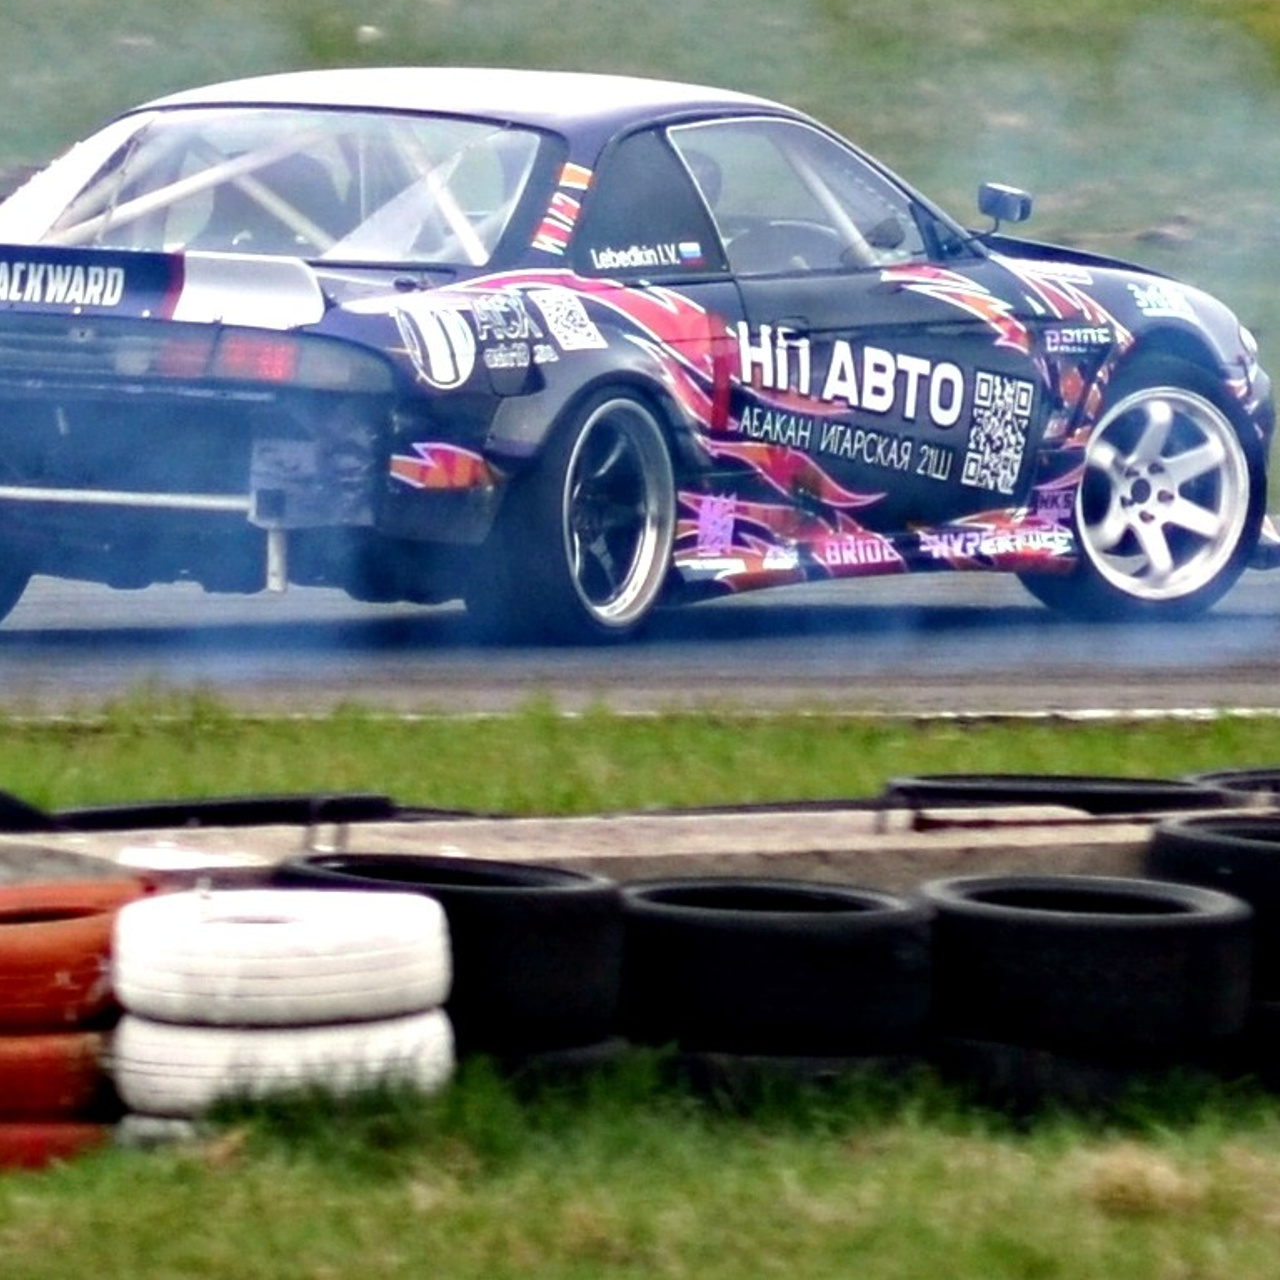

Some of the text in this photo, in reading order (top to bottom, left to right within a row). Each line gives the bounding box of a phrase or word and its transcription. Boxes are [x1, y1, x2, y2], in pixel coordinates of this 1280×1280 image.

[822, 340, 964, 426] АВТО
[739, 406, 812, 449] АБАКАН
[820, 421, 912, 471] ИГАРСКАЯ
